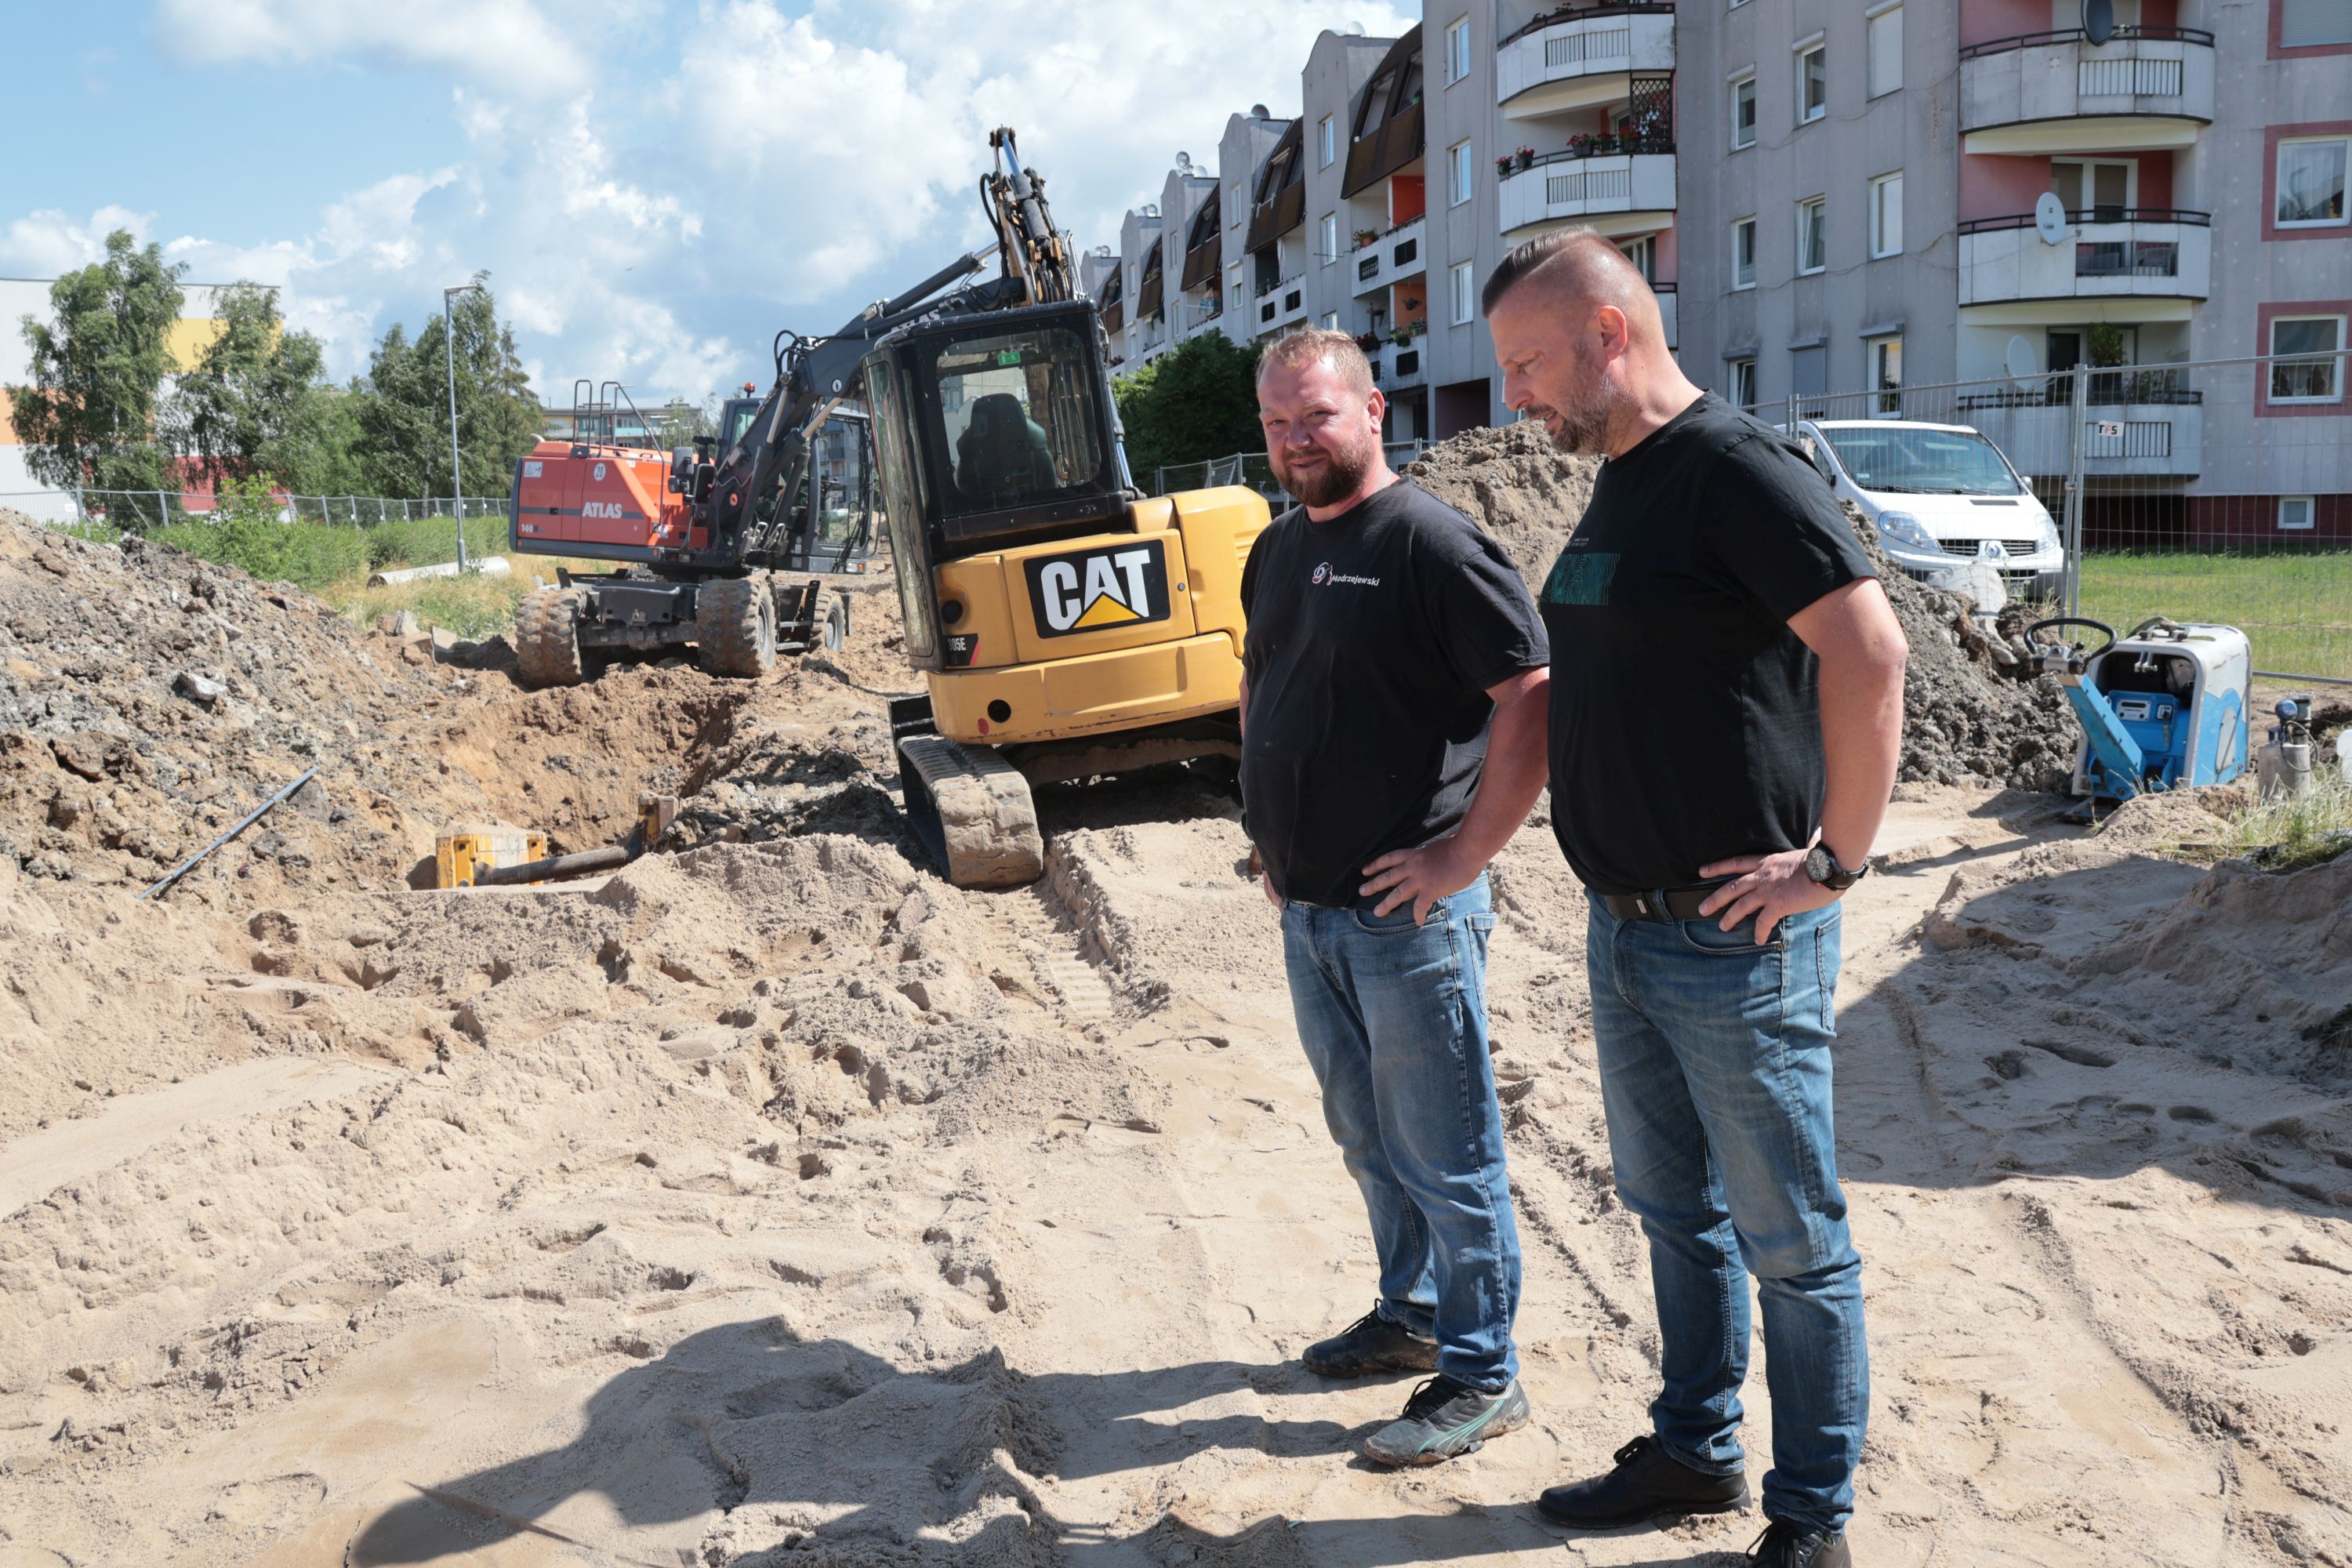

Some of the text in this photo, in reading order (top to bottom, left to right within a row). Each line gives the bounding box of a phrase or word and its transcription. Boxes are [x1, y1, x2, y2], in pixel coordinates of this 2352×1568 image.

[596, 466, 604, 477] 20
[582, 502, 622, 519] ATLAS
[1332, 574, 1381, 586] Modrzejewski
[1040, 549, 1151, 630] CAT
